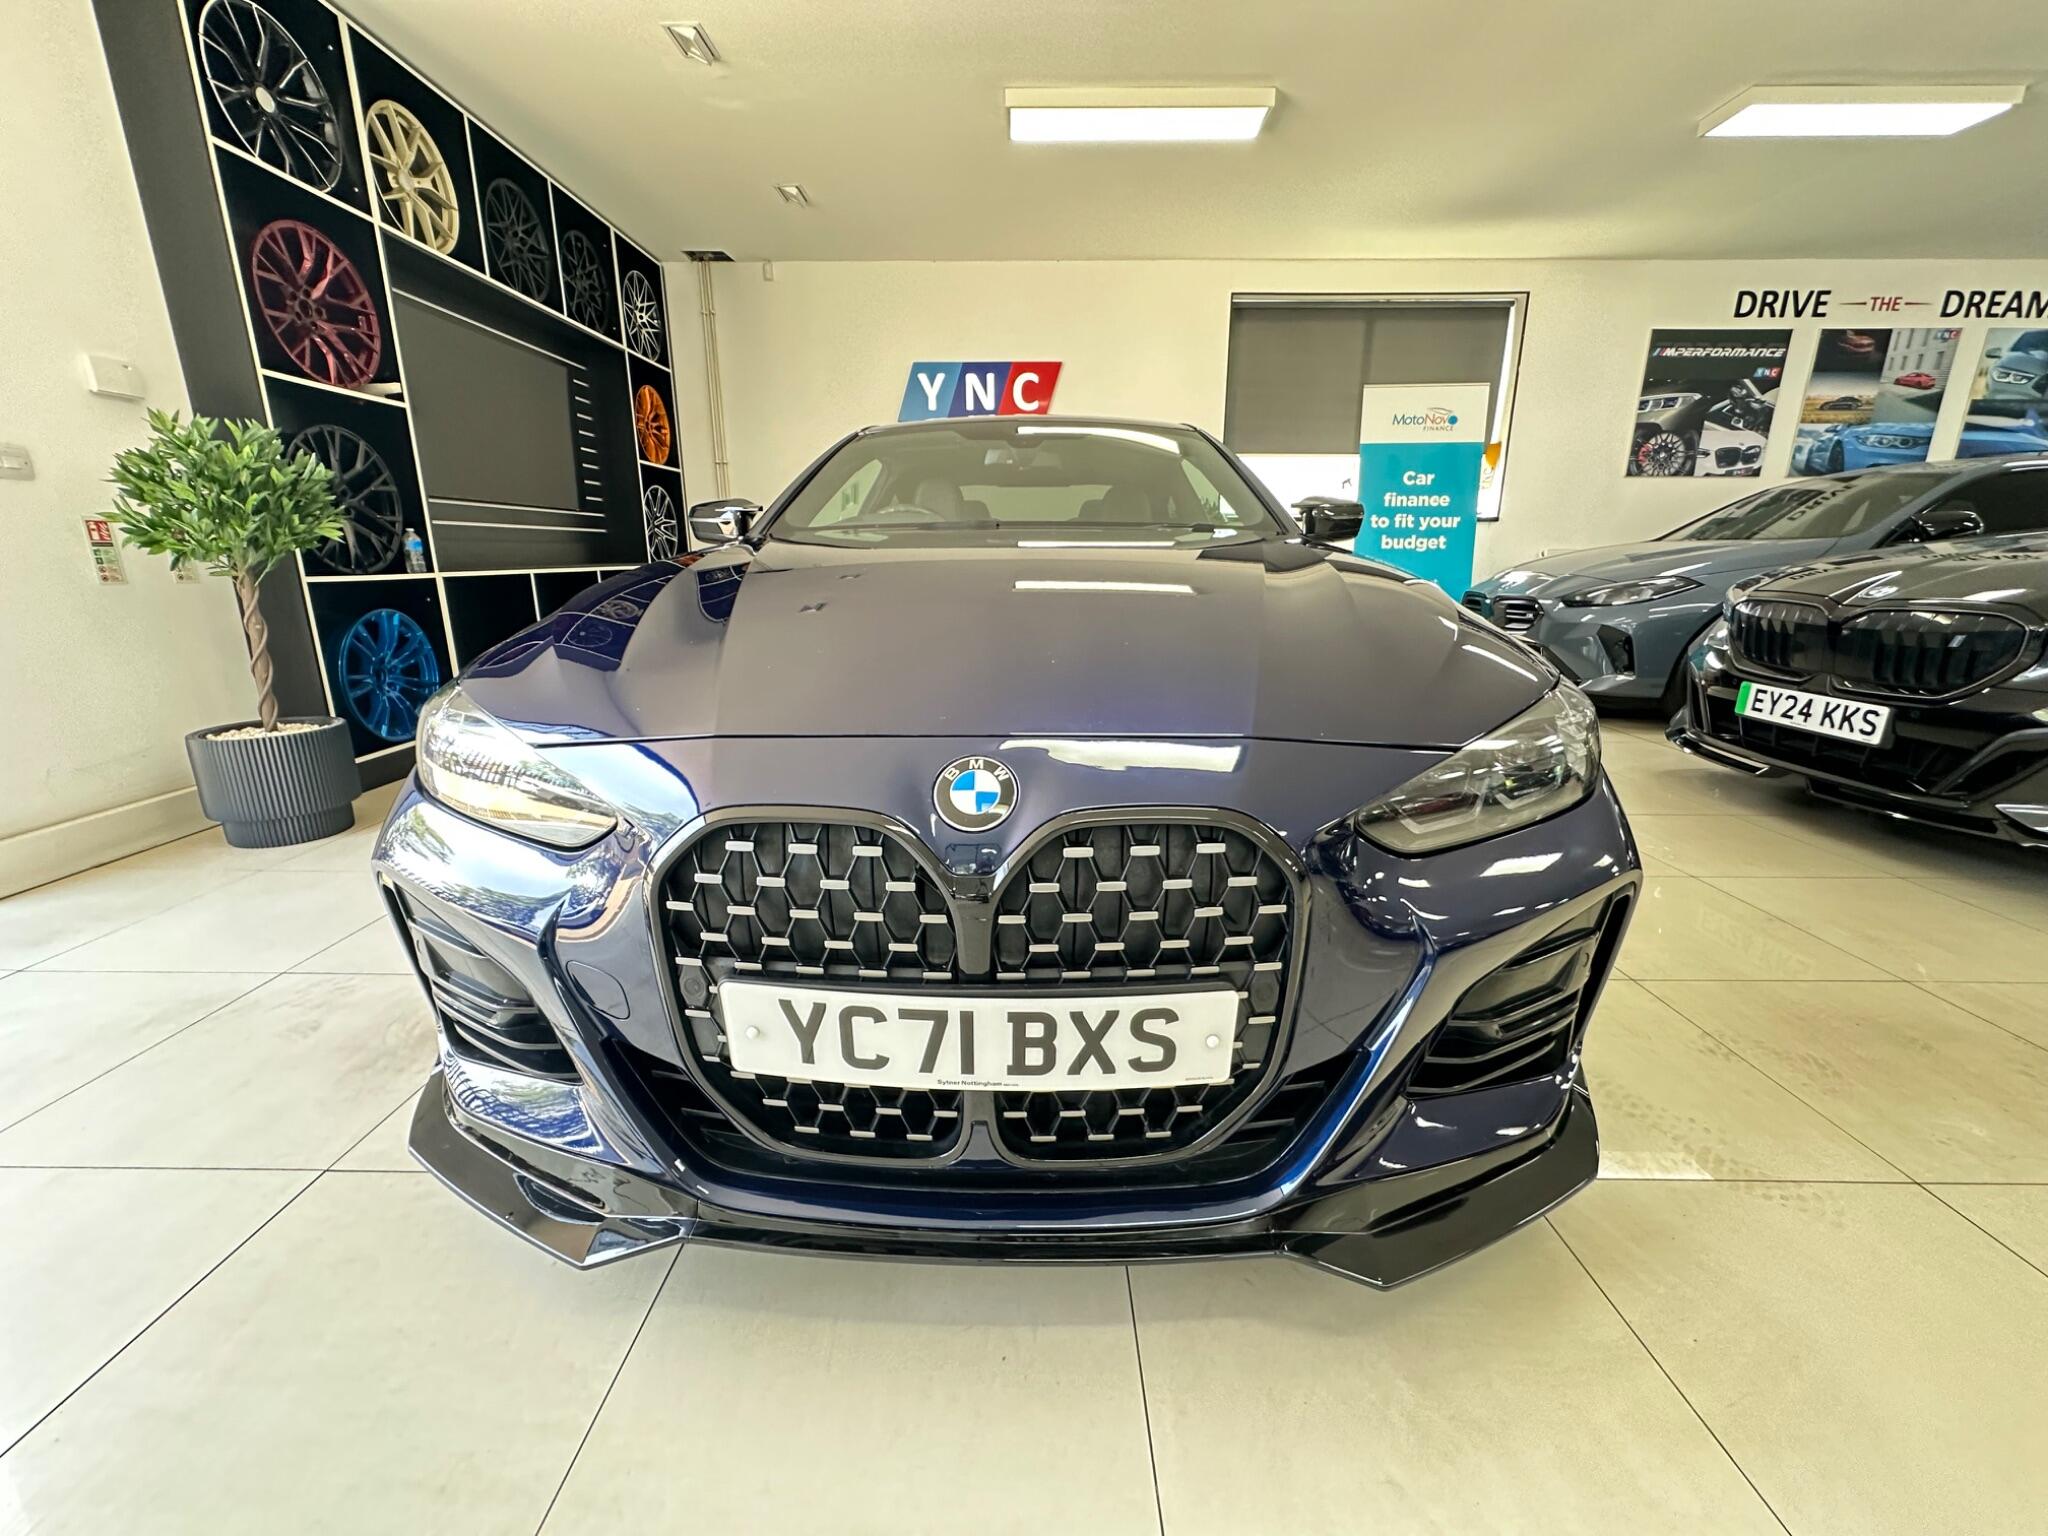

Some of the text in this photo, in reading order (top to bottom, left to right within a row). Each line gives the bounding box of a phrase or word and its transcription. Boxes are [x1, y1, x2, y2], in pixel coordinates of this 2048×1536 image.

[1733, 290, 1832, 318] DRIVE
[1870, 297, 1903, 311] THE
[917, 372, 1040, 412] YNC
[1402, 471, 1435, 486] Car
[1384, 492, 1450, 507] finance
[1370, 514, 1461, 531] to fit your
[1381, 534, 1447, 552] budget
[1751, 688, 1880, 737] EY24 KKS
[944, 759, 1010, 782] BMW
[778, 998, 1181, 1077] YC71 BXS
[961, 1080, 1003, 1088] Nottingham
